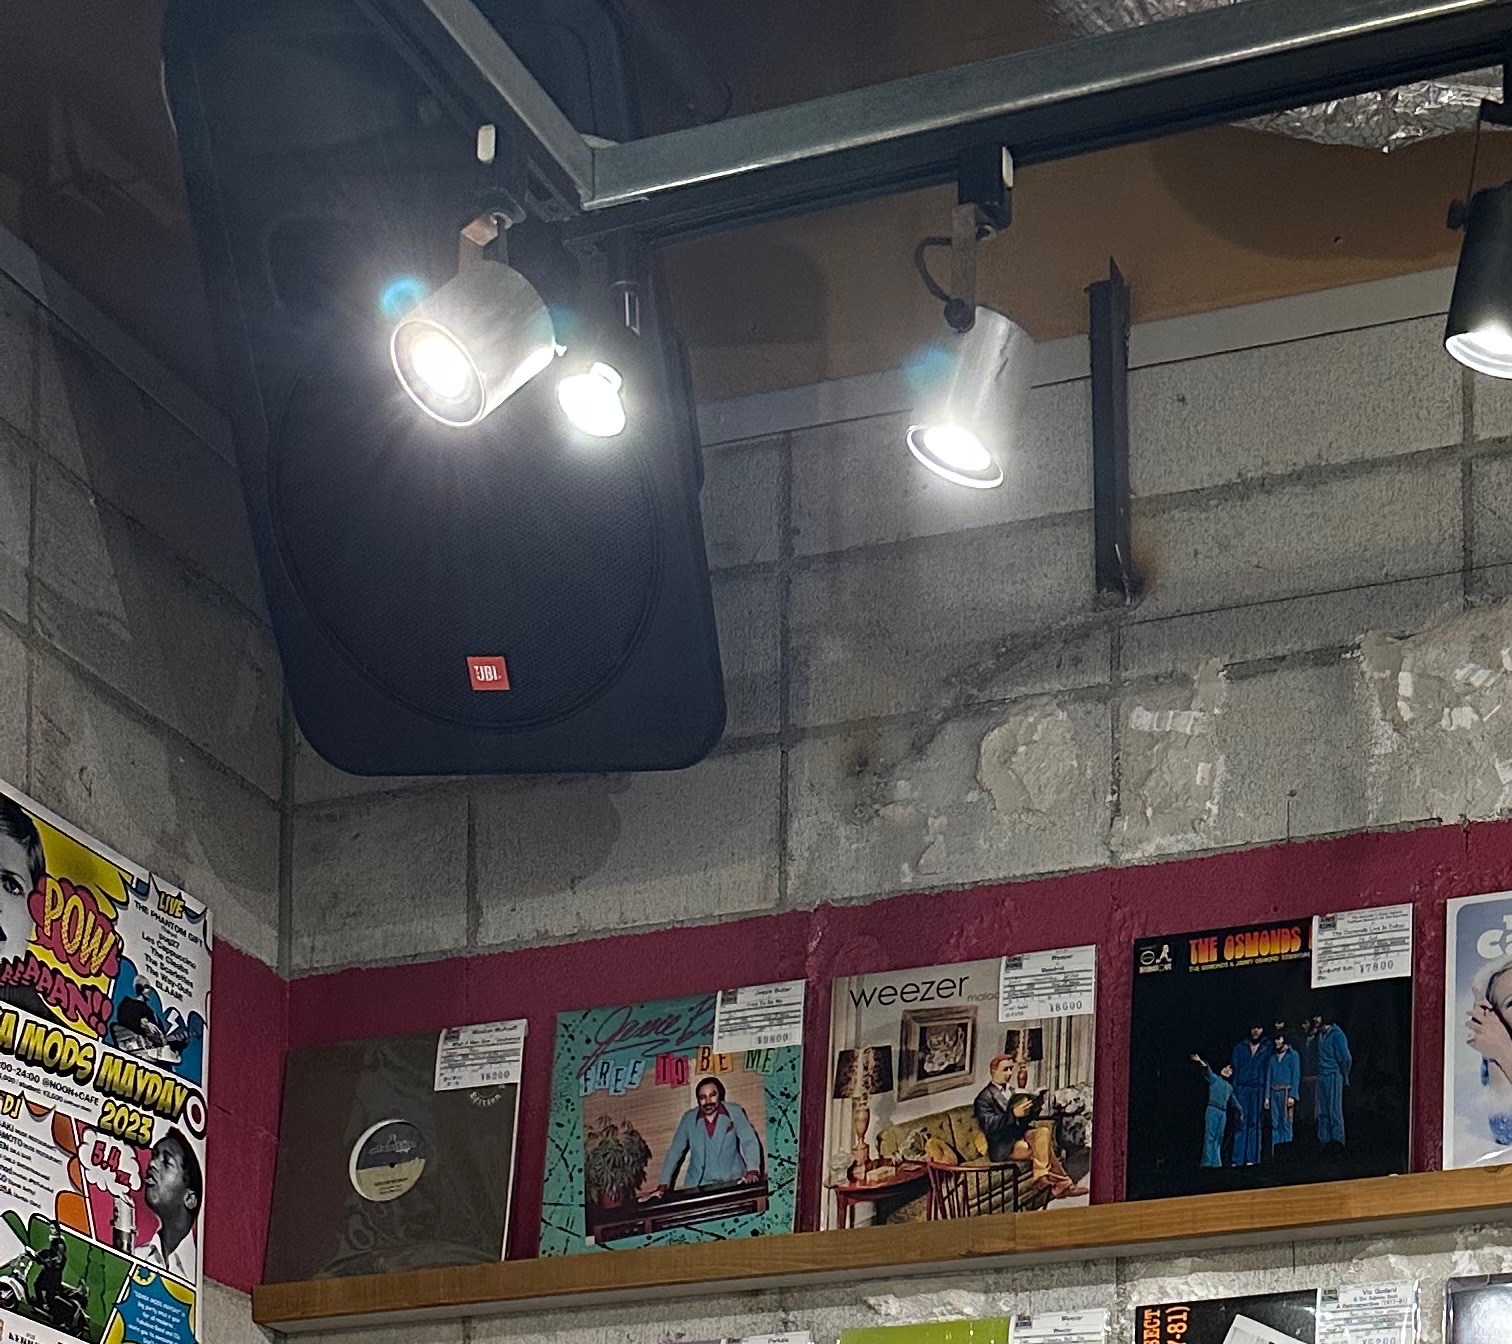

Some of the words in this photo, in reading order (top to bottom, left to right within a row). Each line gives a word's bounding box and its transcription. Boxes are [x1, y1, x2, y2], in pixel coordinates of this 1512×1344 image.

[474, 665, 499, 682] JBL
[158, 890, 186, 919] LIVE
[1189, 937, 1217, 964] THE
[1223, 926, 1302, 956] OSMONDS
[849, 970, 969, 1008] weezer
[20, 1021, 94, 1080] MODS
[97, 1055, 188, 1117] MAYDAY
[583, 1058, 645, 1094] FREE
[699, 1046, 728, 1072] BE
[745, 1047, 776, 1073] ME
[101, 1099, 153, 1147] 2023
